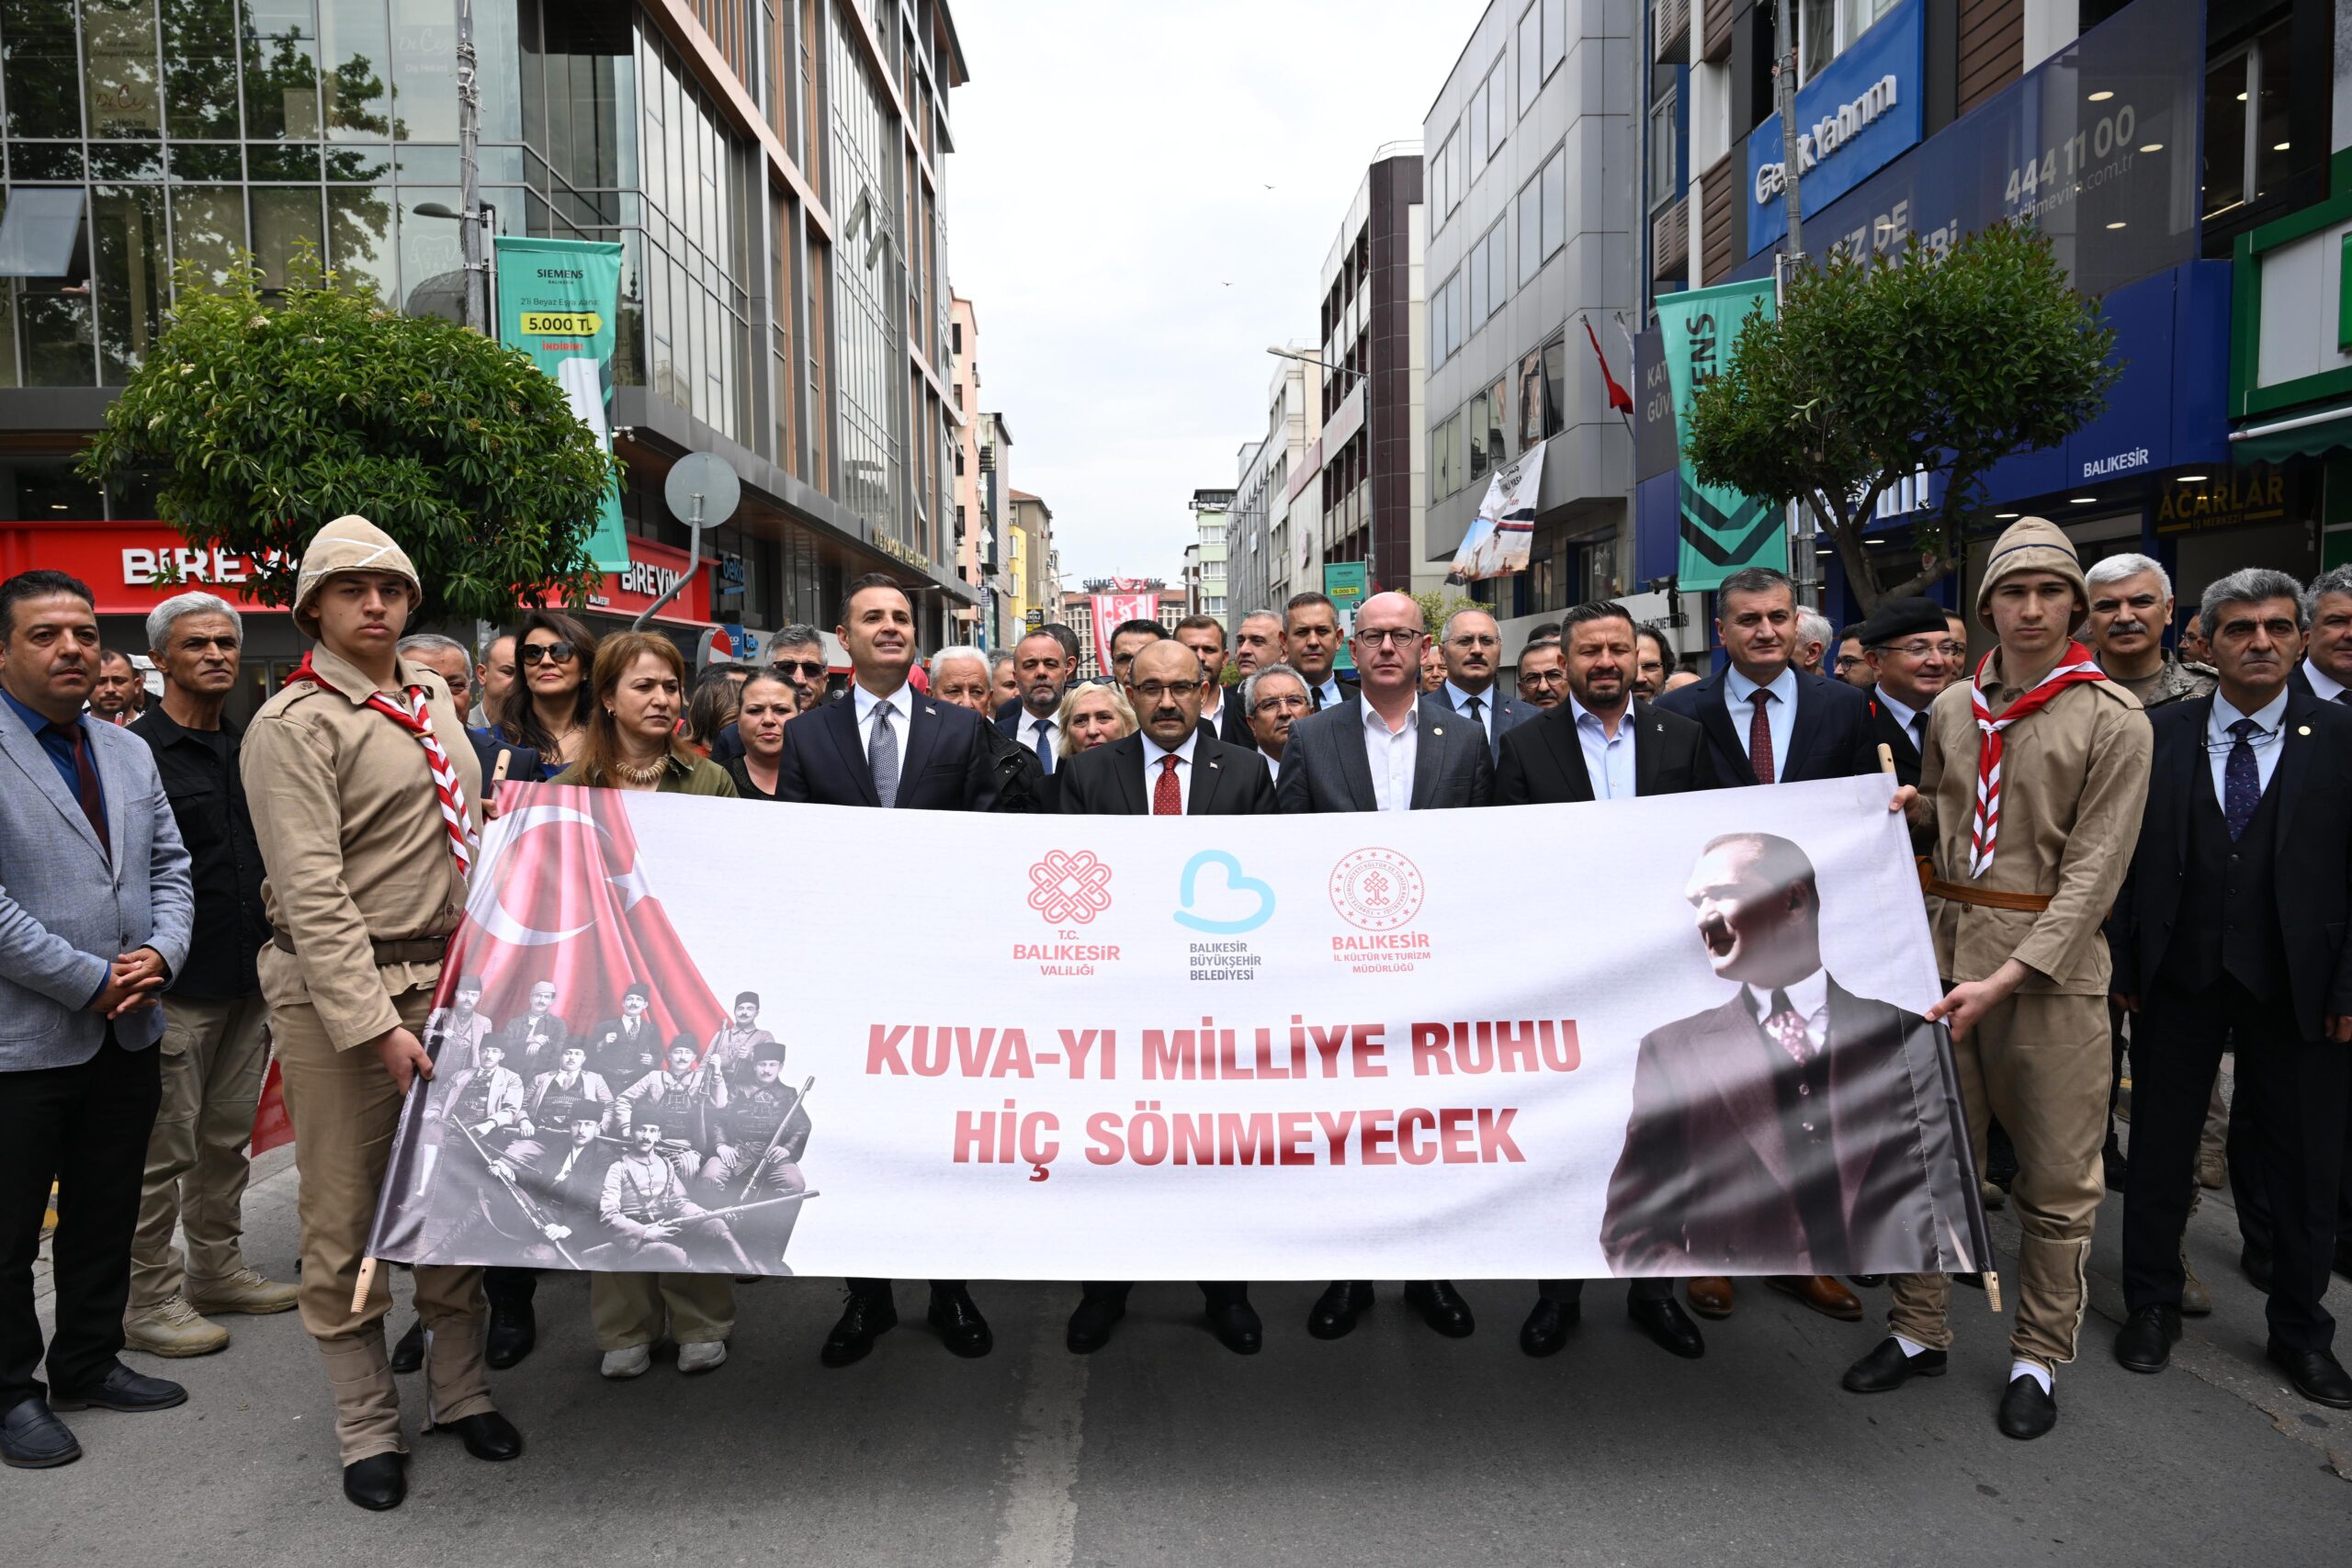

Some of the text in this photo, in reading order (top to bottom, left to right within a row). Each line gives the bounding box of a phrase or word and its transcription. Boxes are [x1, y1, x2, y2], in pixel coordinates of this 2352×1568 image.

[2005, 105, 2135, 205] 444 11 00
[1756, 133, 1816, 204] Gek
[2005, 152, 2135, 230] atilimevim.com.tr
[1873, 198, 1908, 254] DE
[537, 268, 583, 279] SIEMENS
[533, 298, 557, 308] Beyaz
[578, 298, 599, 307] Aana:
[528, 317, 593, 332] 5.000 TL
[1646, 392, 1674, 423] GÜV
[2083, 446, 2149, 478] BALIKESİR
[2158, 474, 2285, 522] ACARLAR
[1057, 930, 1080, 940] T.C.
[1332, 931, 1430, 950] BALIKESİR
[1012, 943, 1120, 960] BALIKESİR
[1190, 940, 1248, 953] BALIKESİR
[1190, 953, 1261, 968] BÜYÜKŞEHİR
[1334, 951, 1431, 962] İL KÜLTÜR VE TURİZM
[1040, 964, 1094, 976] VALİLİĞİ
[1190, 967, 1254, 980] BELEDİYESİ
[1352, 964, 1414, 974] MÜDÜRLÜĞÜ
[865, 1014, 1582, 1081] KUVA-YI MİLLİYE RUHU
[953, 1099, 1526, 1182] HİÇ SÖNMEYECEK
